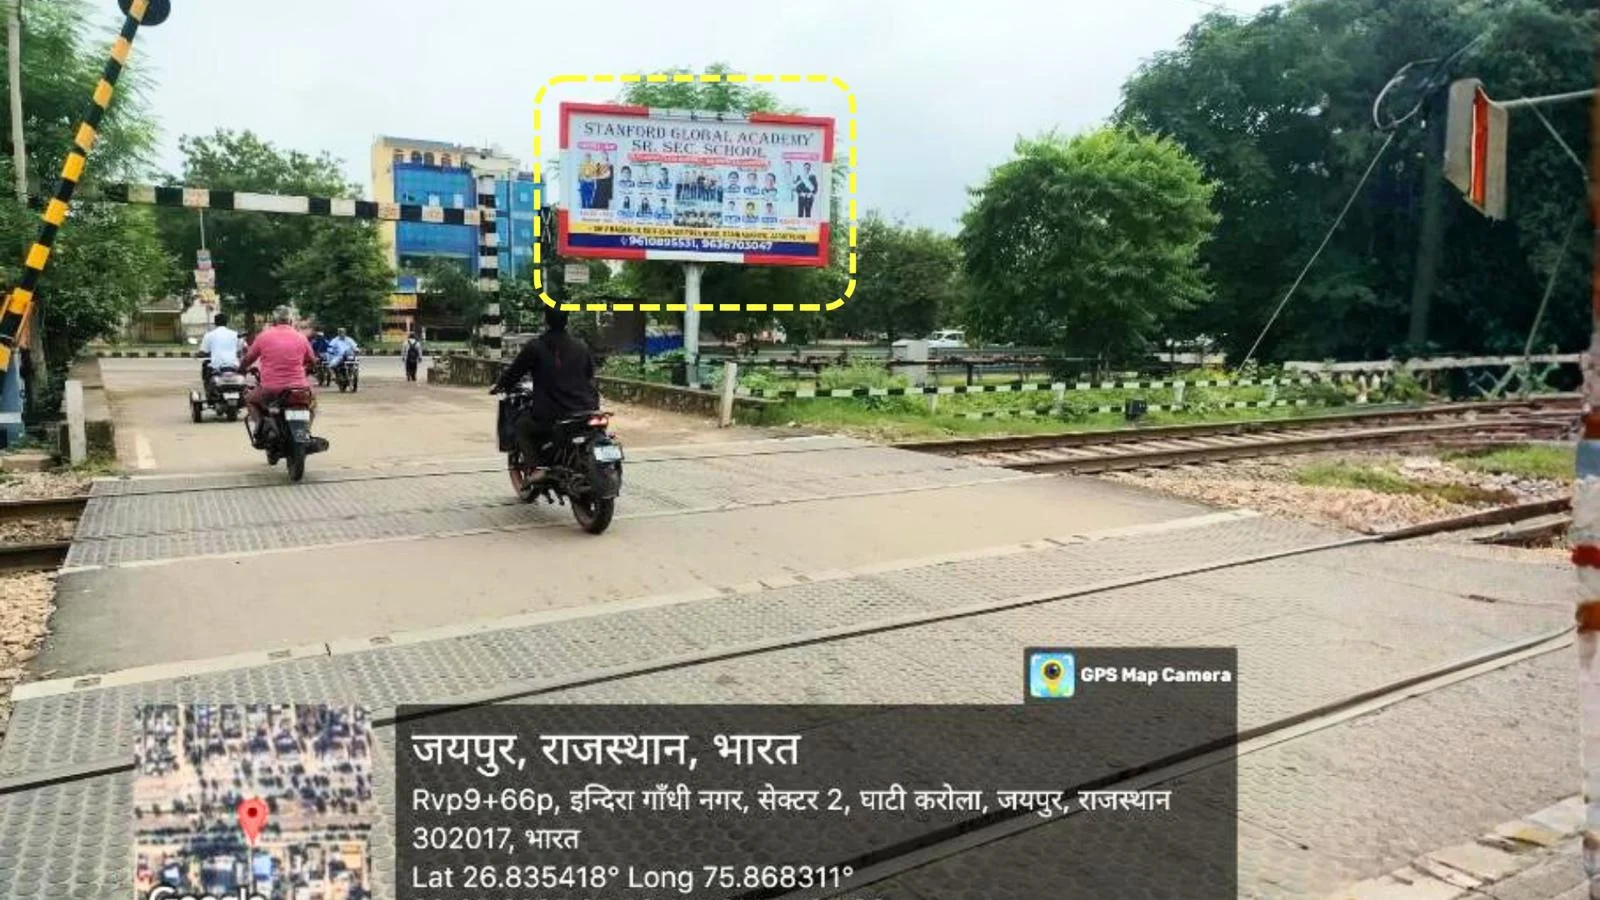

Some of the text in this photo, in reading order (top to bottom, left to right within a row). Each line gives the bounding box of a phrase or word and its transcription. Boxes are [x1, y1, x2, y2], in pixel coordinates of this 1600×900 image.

[584, 121, 814, 146] STANFORD GLOBAL ACADEMY
[631, 139, 657, 152] SR.
[663, 141, 698, 154] SEC.
[704, 144, 767, 158] SCHOOL
